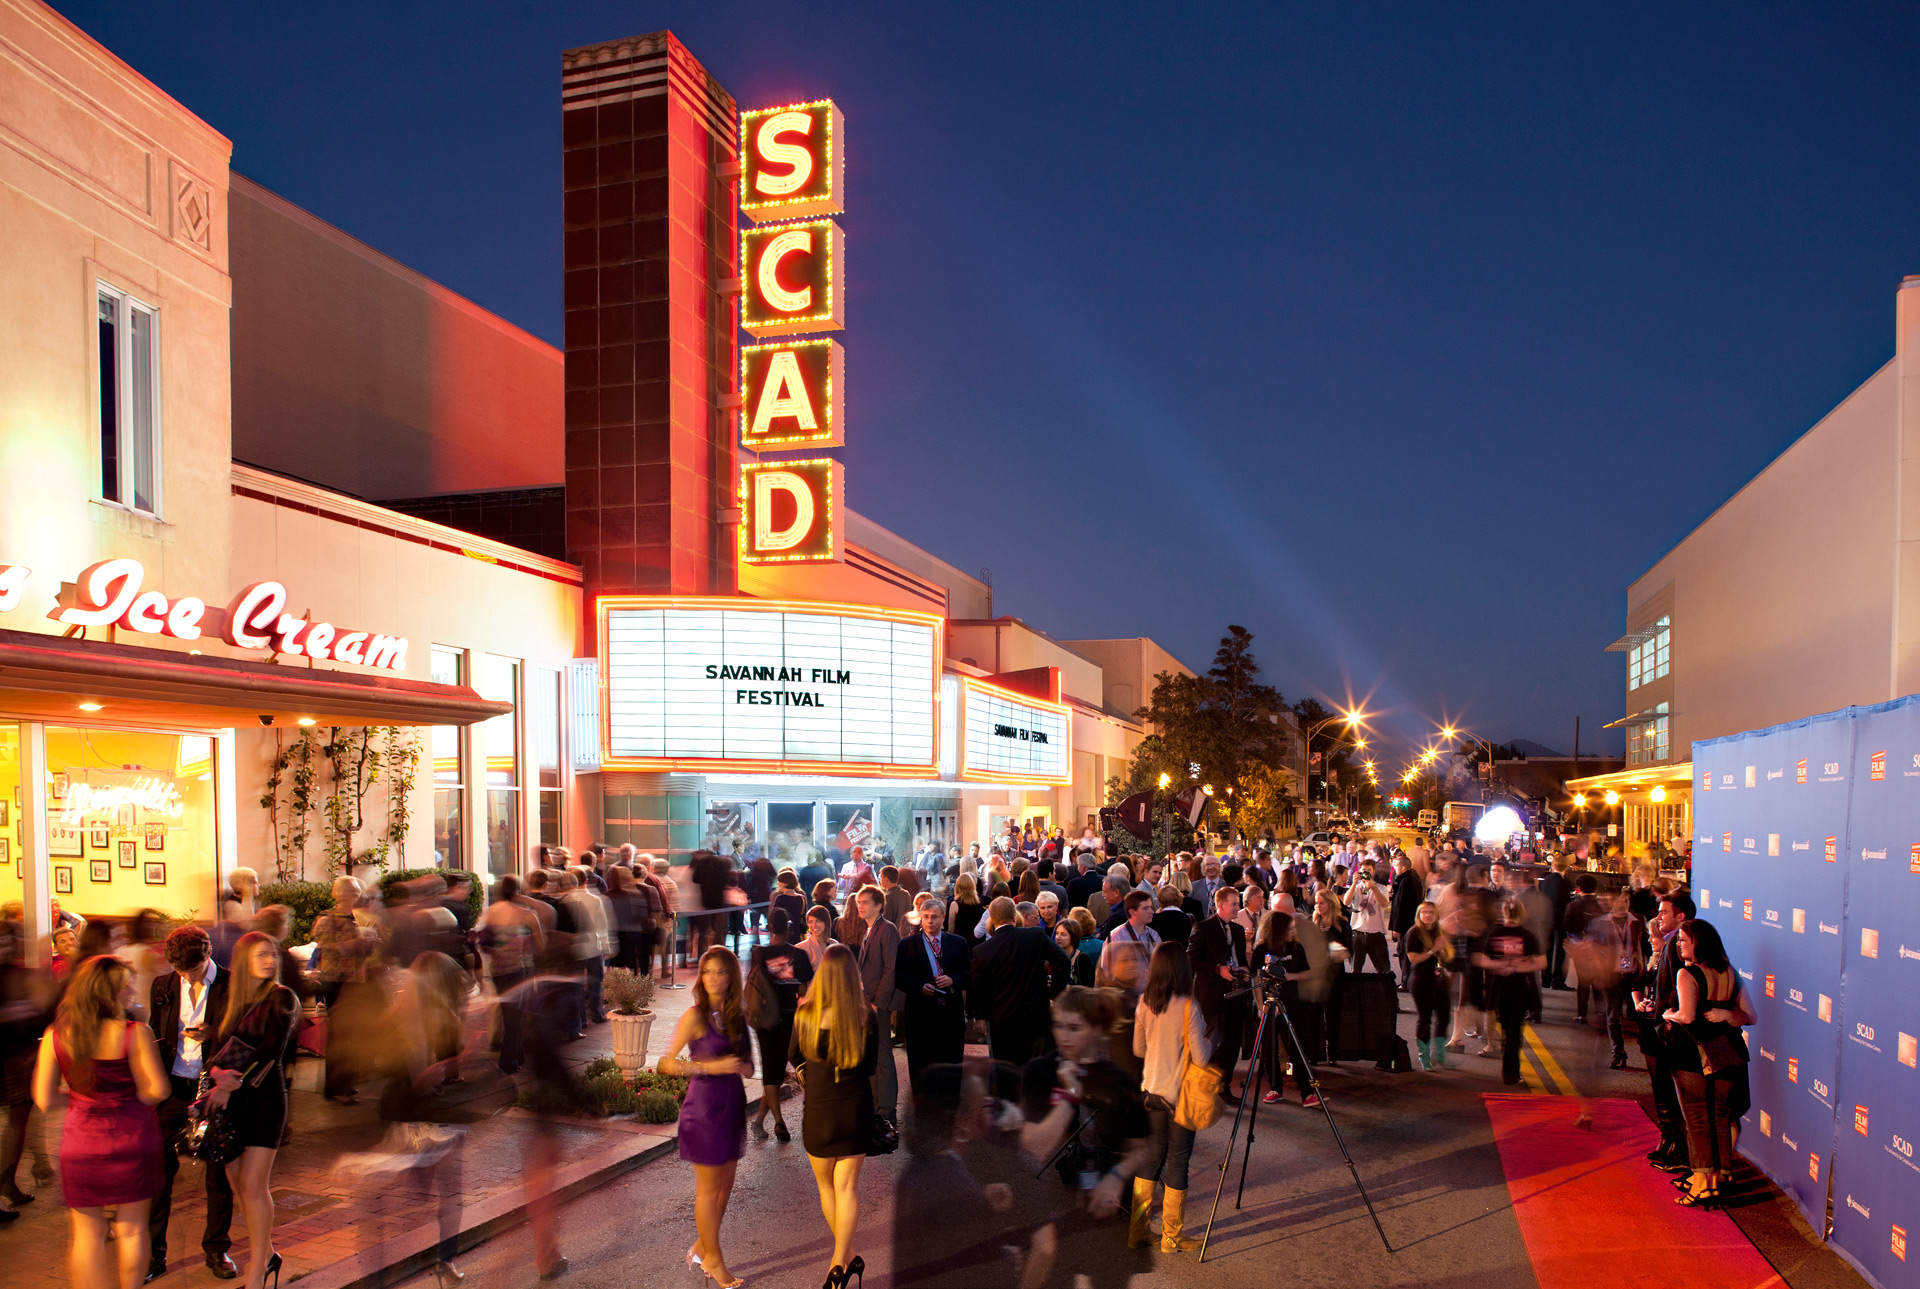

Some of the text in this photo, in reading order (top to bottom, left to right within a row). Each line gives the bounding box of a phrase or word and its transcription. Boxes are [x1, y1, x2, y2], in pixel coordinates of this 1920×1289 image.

[751, 112, 818, 551] SCAD
[59, 558, 205, 640] Ice
[232, 581, 409, 671] Cream
[706, 665, 850, 684] SAVANNAH FILM
[737, 690, 824, 707] FESTIVAL
[1020, 729, 1029, 741] FILM
[1032, 731, 1049, 744] FESTIVAL
[1824, 762, 1839, 775] SCAD
[1871, 760, 1885, 772] FILM
[110, 823, 169, 838] ICE CREAM
[845, 823, 868, 840] FILM
[1790, 988, 1803, 1003] SCAD
[1856, 1022, 1875, 1041] SCAD
[1814, 1078, 1828, 1097] SCAD
[1893, 1134, 1913, 1157] SCAD
[1891, 1231, 1905, 1252] FILM
